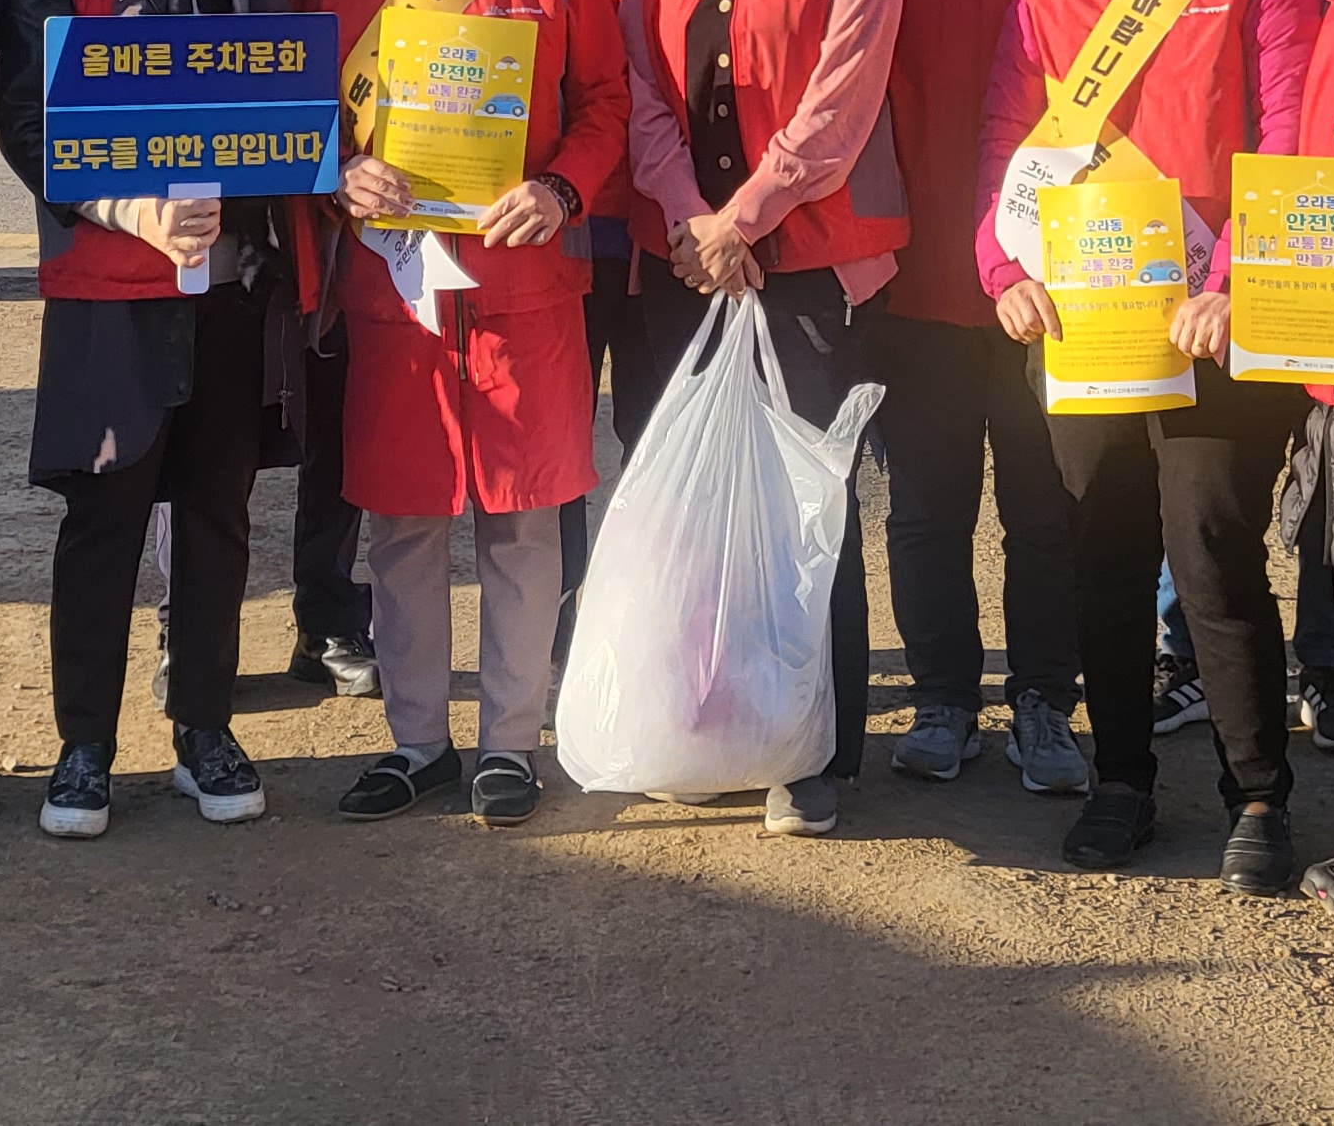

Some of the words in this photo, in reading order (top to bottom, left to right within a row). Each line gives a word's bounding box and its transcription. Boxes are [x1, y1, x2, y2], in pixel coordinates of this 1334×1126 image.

[82, 43, 172, 77] 올바른
[186, 40, 307, 74] 주차문화
[439, 46, 477, 62] 오라동
[428, 62, 485, 84] 안전한
[456, 85, 482, 100] 환경
[434, 100, 472, 115] 만들기
[53, 137, 138, 171] 모두를
[147, 135, 205, 168] 위한
[212, 132, 323, 167] 일입니다
[1014, 183, 1037, 204] 오라
[1086, 218, 1122, 233] 오라동
[1079, 236, 1133, 255] 안전한
[1287, 236, 1315, 250] 교통
[1081, 258, 1104, 272] 교통
[1108, 257, 1134, 271] 환경
[1089, 274, 1127, 288] 만들기
